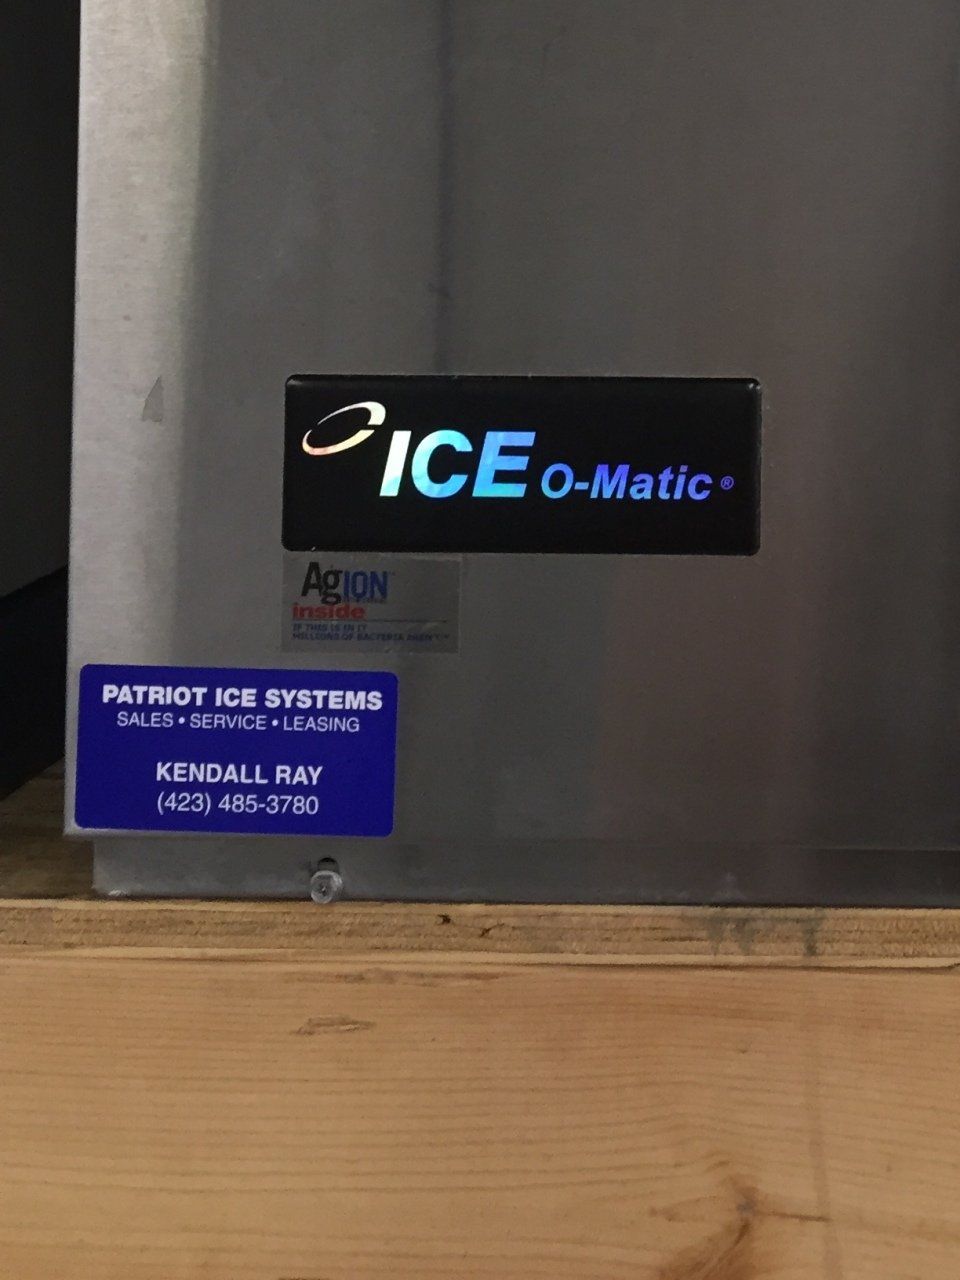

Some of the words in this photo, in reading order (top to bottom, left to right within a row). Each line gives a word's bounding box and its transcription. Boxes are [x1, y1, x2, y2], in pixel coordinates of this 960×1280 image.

[379, 430, 536, 498] ICE
[291, 603, 366, 619] inside
[102, 684, 208, 705] PATRIOT
[214, 687, 257, 708] ICE
[264, 689, 383, 711] SYSTEMS
[116, 712, 174, 727] SALES
[189, 714, 267, 731] SERVICE
[283, 717, 360, 733] LEASING
[155, 762, 268, 785] KENDALL
[275, 766, 323, 786] RAY
[157, 791, 212, 816] (423)
[217, 793, 319, 815] 485-3780
